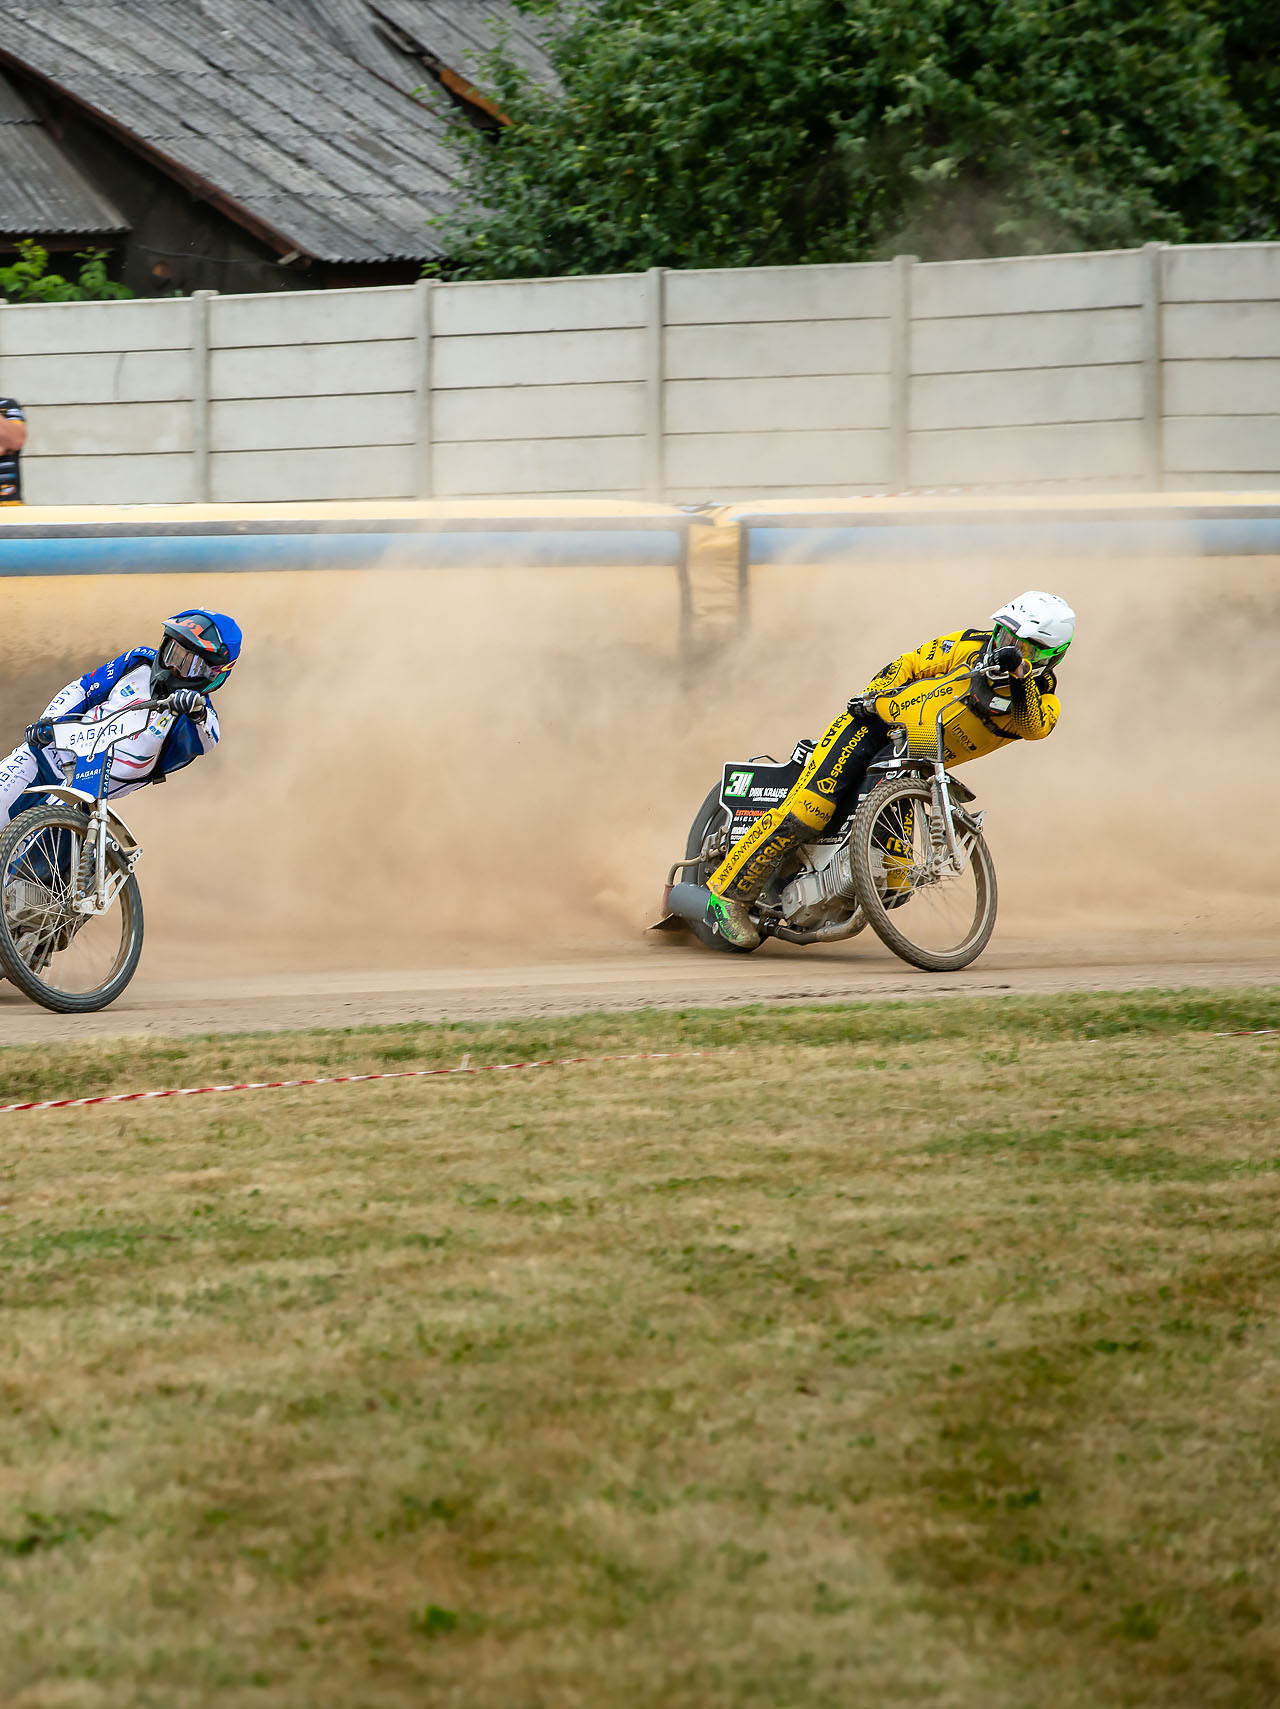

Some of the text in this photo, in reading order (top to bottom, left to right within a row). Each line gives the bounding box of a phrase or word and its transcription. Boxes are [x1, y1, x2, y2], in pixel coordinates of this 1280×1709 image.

[900, 685, 953, 711] spechouse
[69, 723, 124, 746] SAGARI
[830, 725, 869, 778] spechouse
[763, 787, 788, 799] KRAUSE
